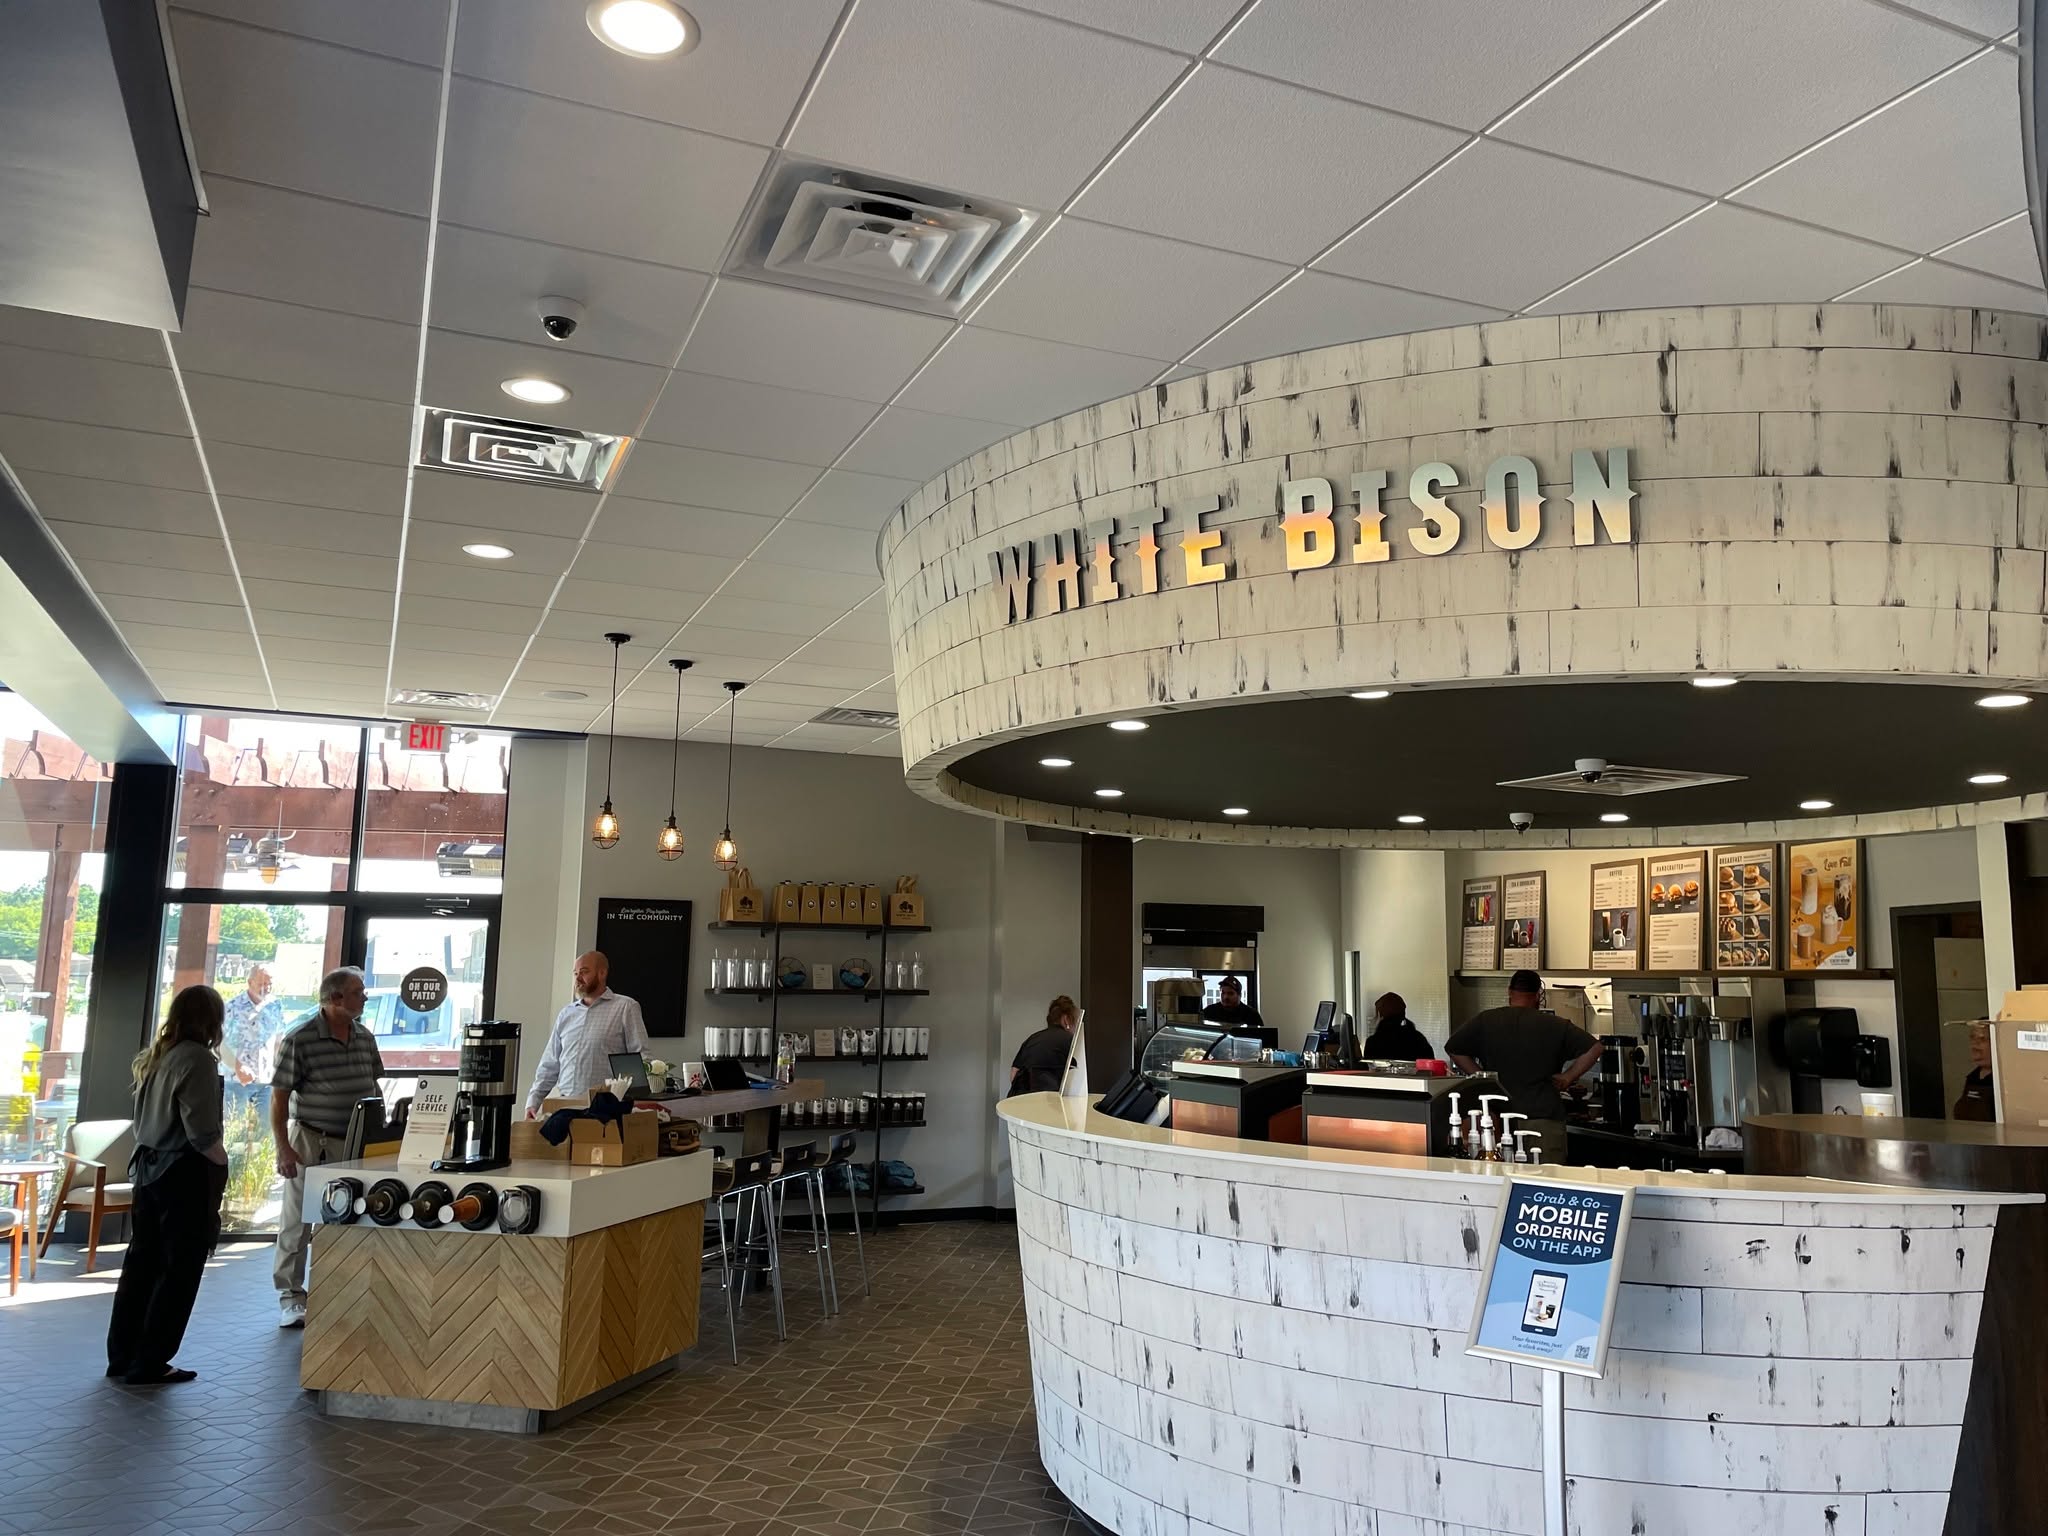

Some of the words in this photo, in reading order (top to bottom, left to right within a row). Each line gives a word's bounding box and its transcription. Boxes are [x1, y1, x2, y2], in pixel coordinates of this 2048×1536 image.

[986, 494, 1227, 624] WHITE
[1278, 448, 1639, 571] BISON
[409, 724, 445, 750] EXIT
[408, 982, 420, 991] ON
[423, 982, 441, 991] OUR
[411, 991, 436, 1001] PATIO
[415, 1103, 448, 1112] SERVICE
[424, 1094, 444, 1103] SELF
[1533, 1191, 1566, 1206] Grab
[1568, 1194, 1580, 1207] &
[1582, 1196, 1601, 1210] Go
[1518, 1203, 1609, 1230] MOBILE
[1515, 1222, 1606, 1245] ORDERING
[1512, 1237, 1537, 1250] ON
[1540, 1240, 1569, 1255] THE
[1571, 1244, 1602, 1258] APP
